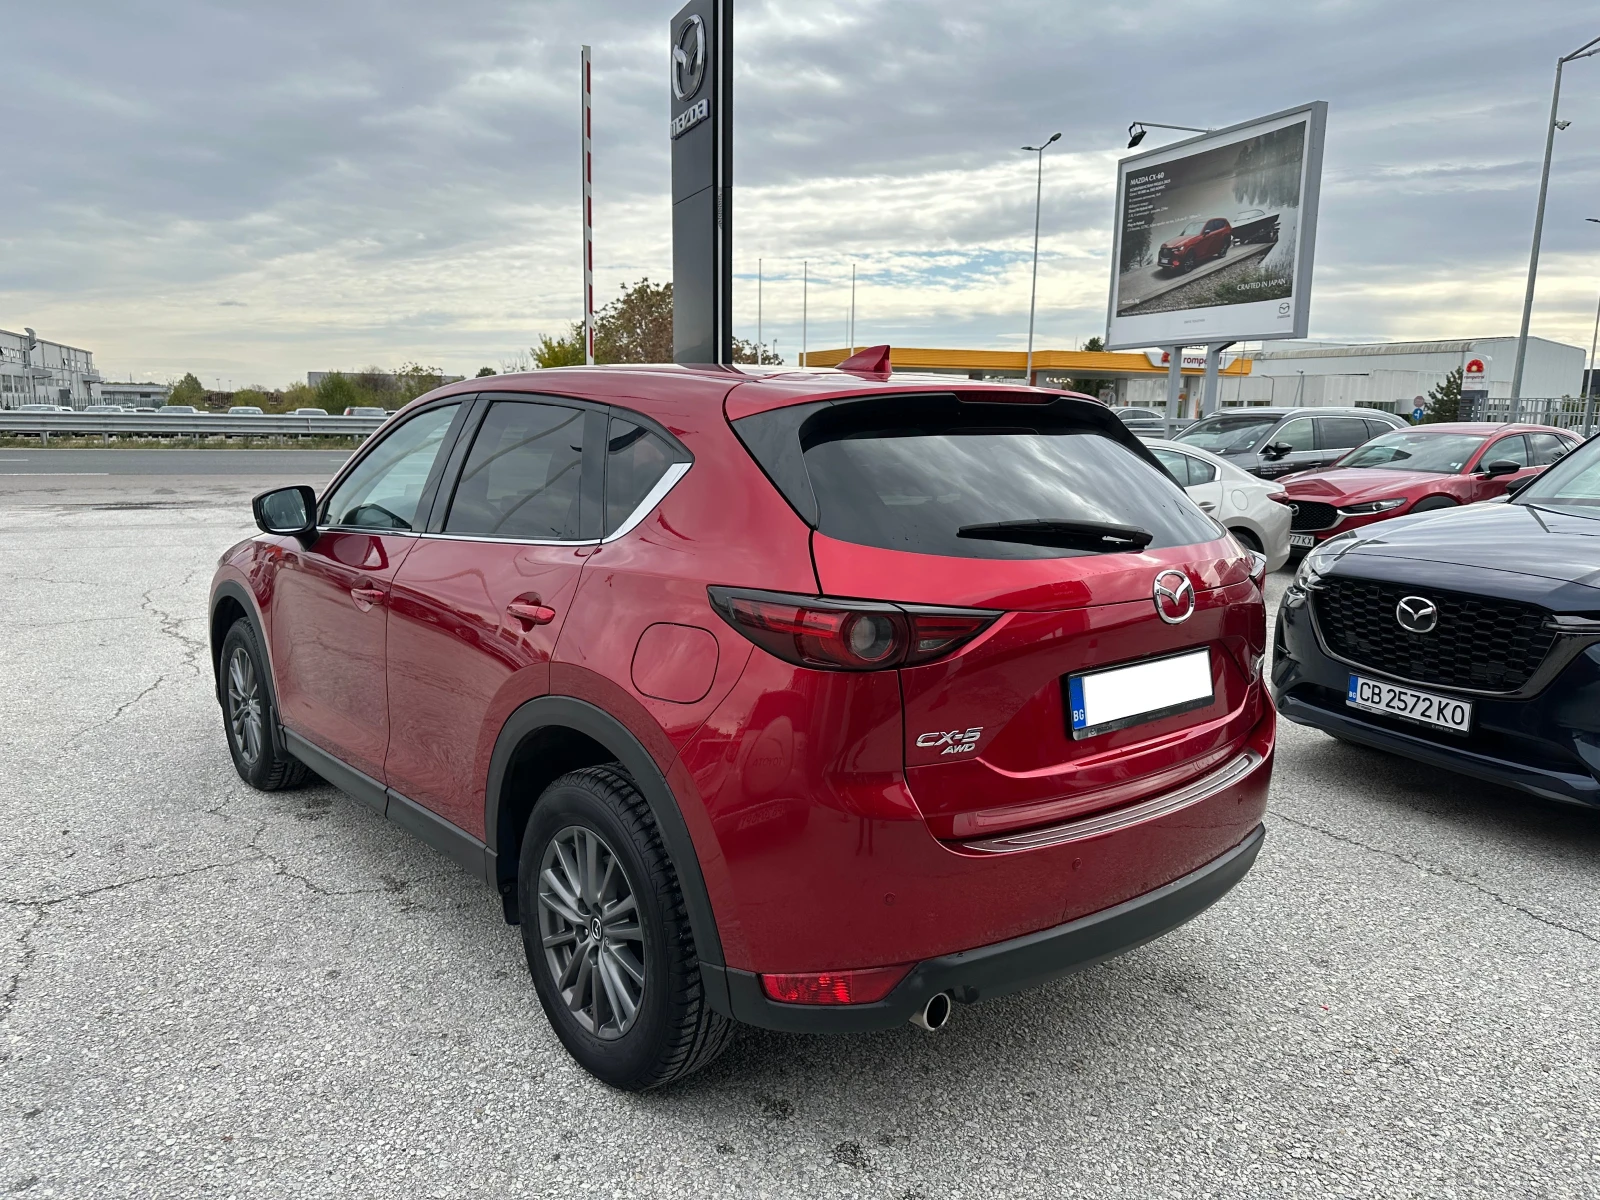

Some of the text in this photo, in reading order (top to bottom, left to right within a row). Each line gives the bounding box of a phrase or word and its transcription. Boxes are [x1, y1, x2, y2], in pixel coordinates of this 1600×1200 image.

[1130, 176, 1149, 186] MAZDA
[1149, 172, 1165, 181] CX-60
[1237, 282, 1260, 290] CRAFTED
[1268, 278, 1286, 287] JAPAN
[1349, 690, 1357, 699] BG
[1360, 681, 1465, 726] CB 2572 KO
[1073, 709, 1085, 722] BG
[916, 726, 984, 747] CX-5
[941, 743, 976, 755] AWD
